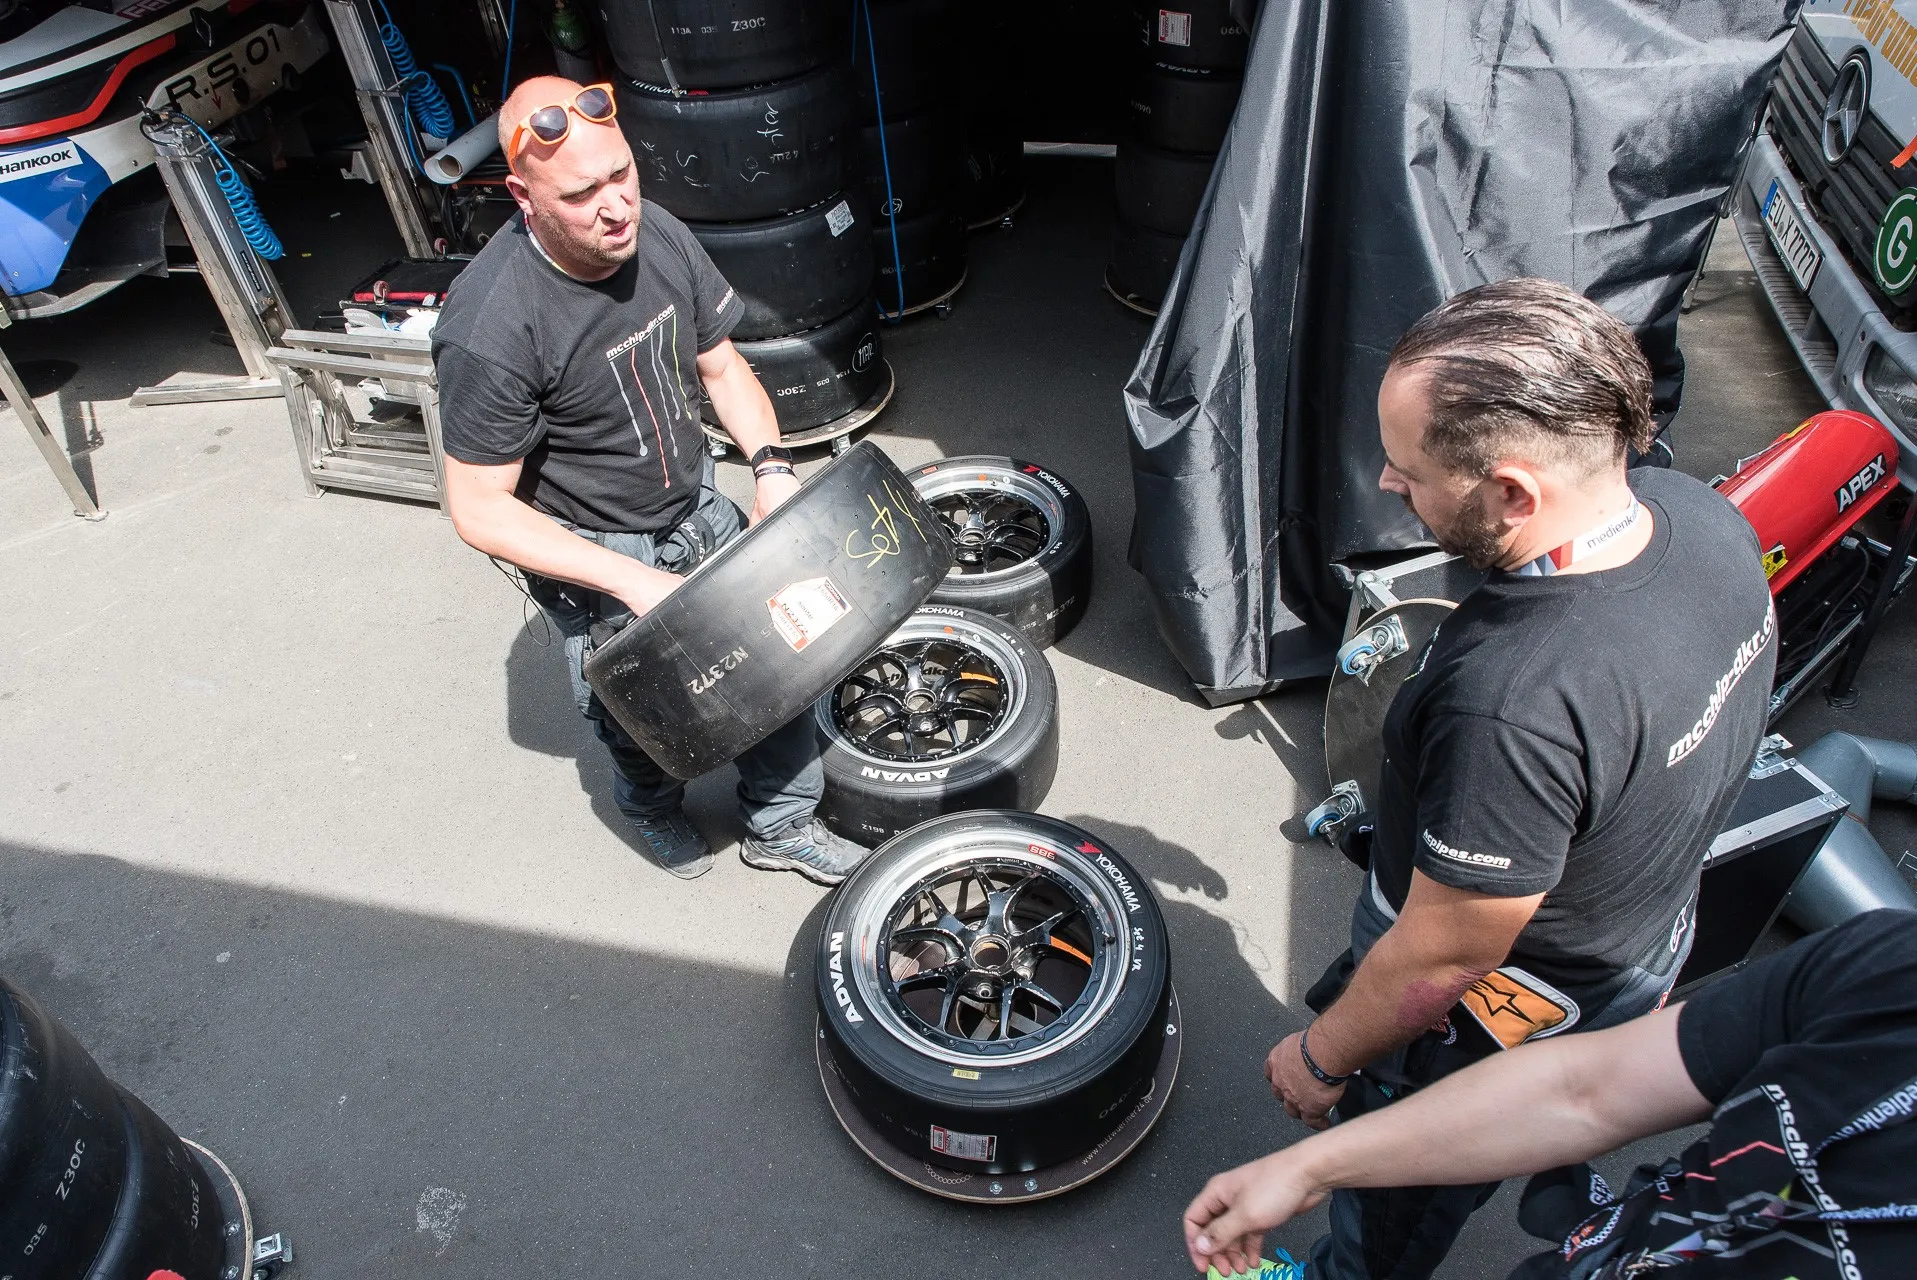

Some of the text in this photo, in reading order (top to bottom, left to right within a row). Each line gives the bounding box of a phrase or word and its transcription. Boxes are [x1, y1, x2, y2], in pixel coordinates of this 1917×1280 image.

[165, 28, 280, 105] R.S.01
[1768, 192, 1786, 230] EU
[1886, 215, 1914, 269] G
[1038, 470, 1071, 499] YOKOHAMA
[1839, 454, 1886, 514] APEX
[915, 607, 964, 618] OKOHAMA
[687, 646, 749, 695] N2372
[861, 765, 950, 782] ADVAN
[1096, 853, 1141, 912] YOKOHAMA
[829, 932, 863, 1023] ADVAN
[55, 1138, 86, 1201] Z30C
[190, 1178, 200, 1230] Z30C
[24, 1222, 48, 1256] 035
